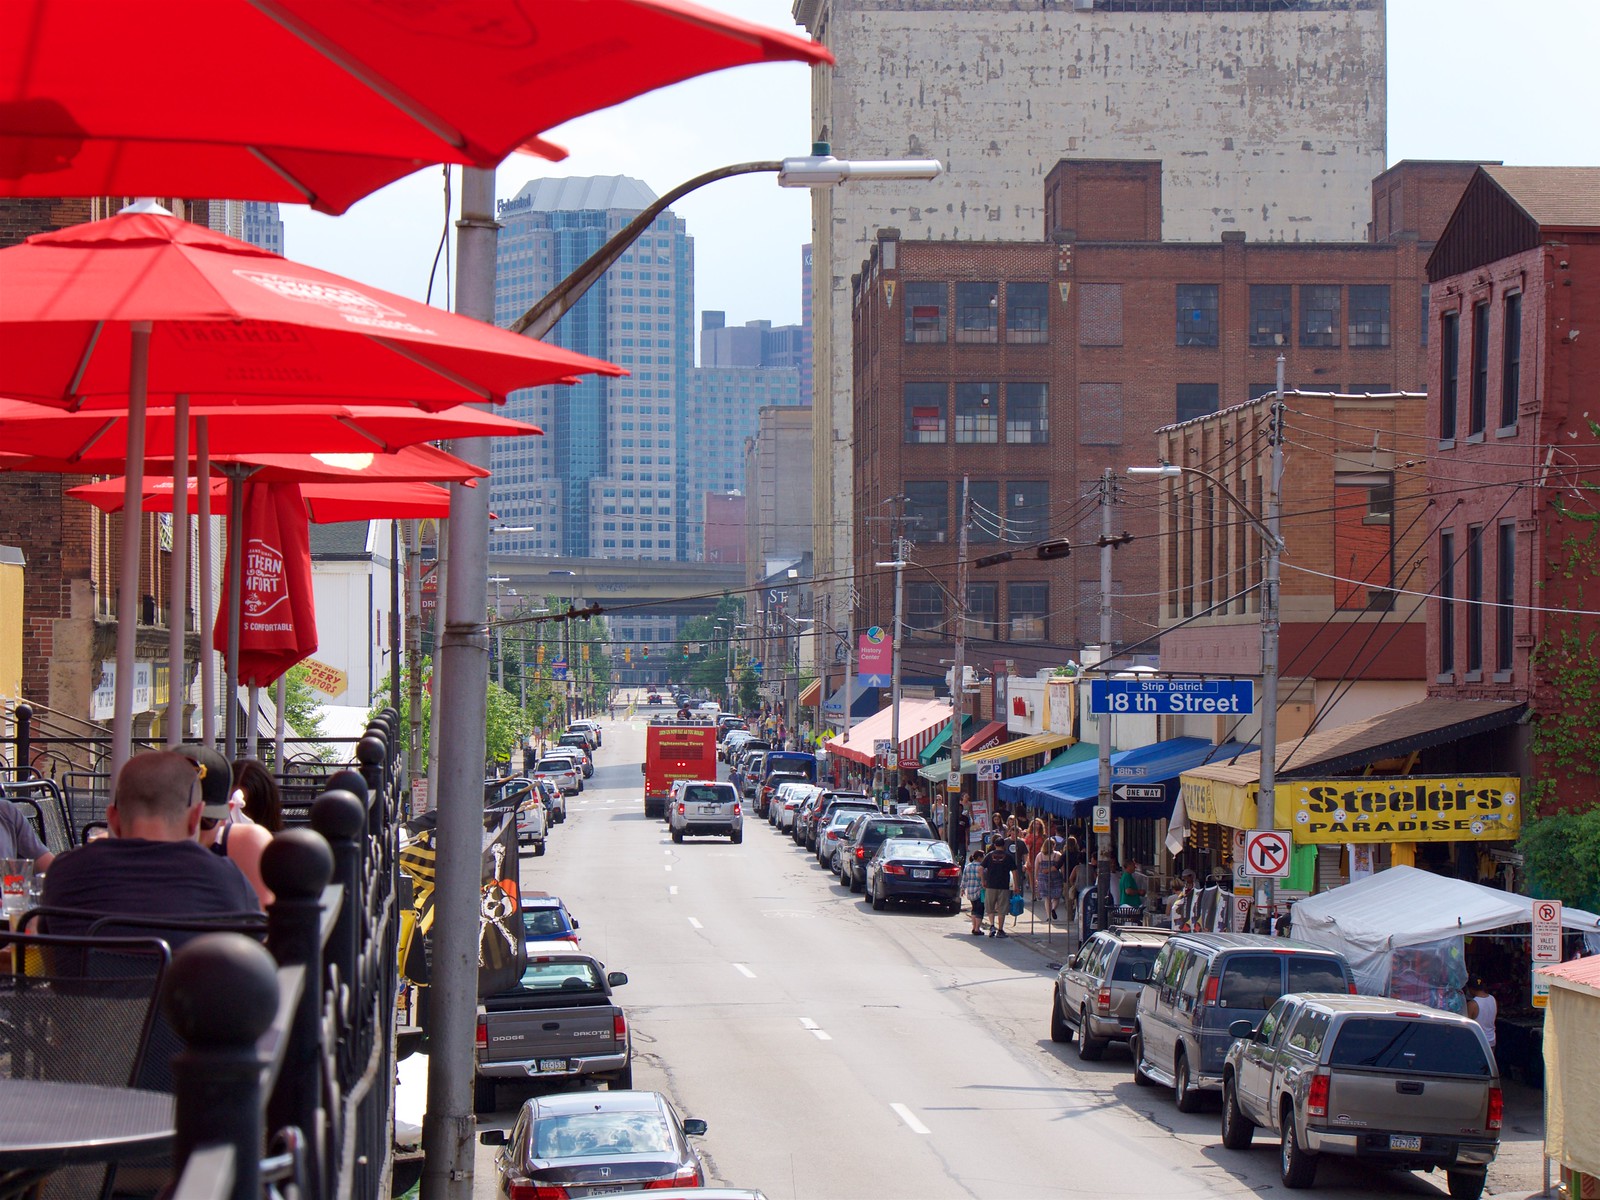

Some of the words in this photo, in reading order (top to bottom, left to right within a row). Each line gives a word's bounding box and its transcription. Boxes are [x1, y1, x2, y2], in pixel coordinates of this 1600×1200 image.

[861, 647, 882, 655] History
[1141, 682, 1165, 693] Strip
[1168, 682, 1204, 691] District
[1169, 693, 1239, 712] Street
[1117, 767, 1133, 775] 18th
[1135, 767, 1144, 775] St
[1126, 788, 1140, 796] ONE
[1143, 788, 1159, 797] WAY
[1309, 785, 1503, 813] Steelers
[1309, 819, 1470, 833] PARADISE
[493, 1034, 525, 1042] DODGE
